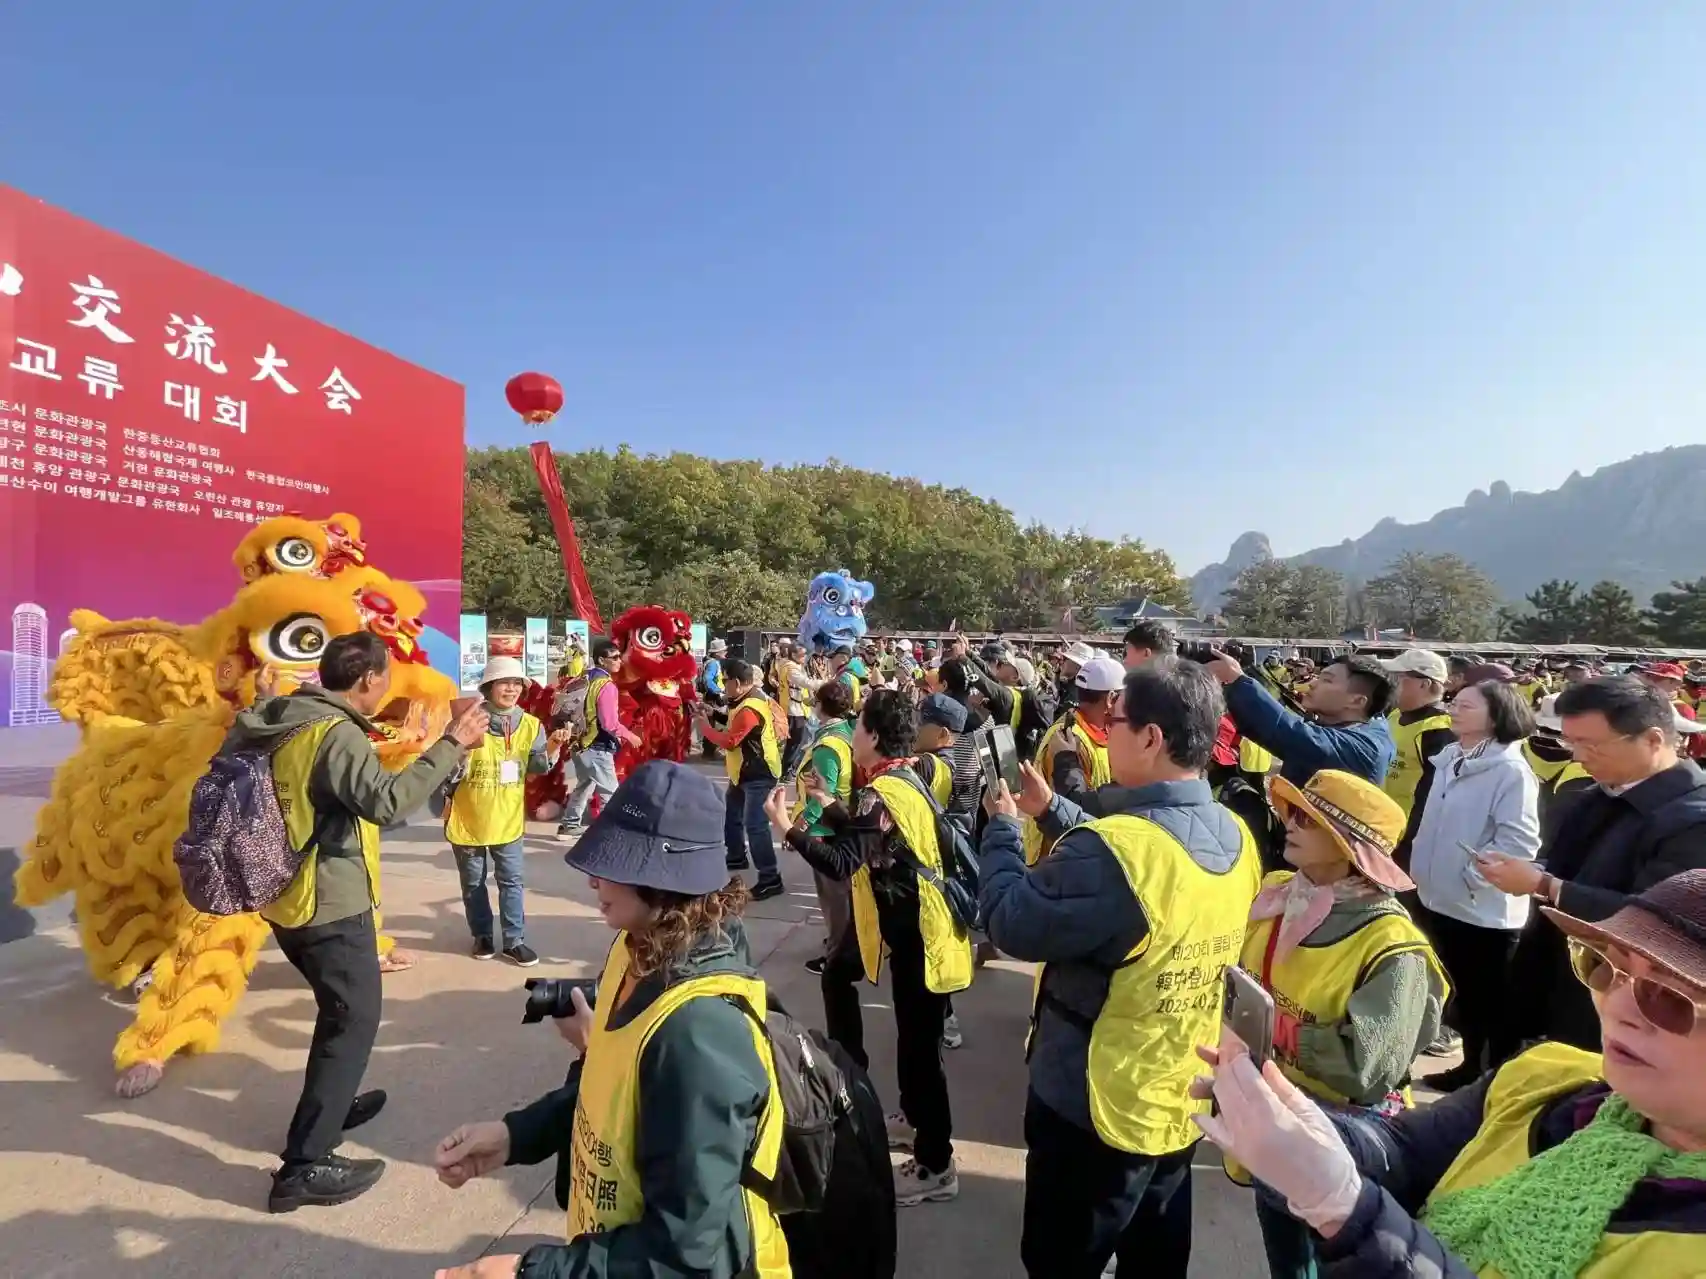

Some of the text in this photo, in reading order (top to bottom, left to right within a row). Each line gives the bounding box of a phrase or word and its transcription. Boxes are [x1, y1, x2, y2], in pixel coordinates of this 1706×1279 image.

[10, 337, 248, 433] 교류 대회
[34, 408, 107, 435] 문화관광국
[34, 425, 107, 450] 문화관광국
[32, 462, 63, 476] 휴양
[69, 467, 111, 484] 관광구
[117, 476, 180, 496] 문화관광국
[33, 443, 107, 468] 문화관광국
[153, 466, 213, 486] 문화관광국
[152, 498, 200, 515] 유한회사
